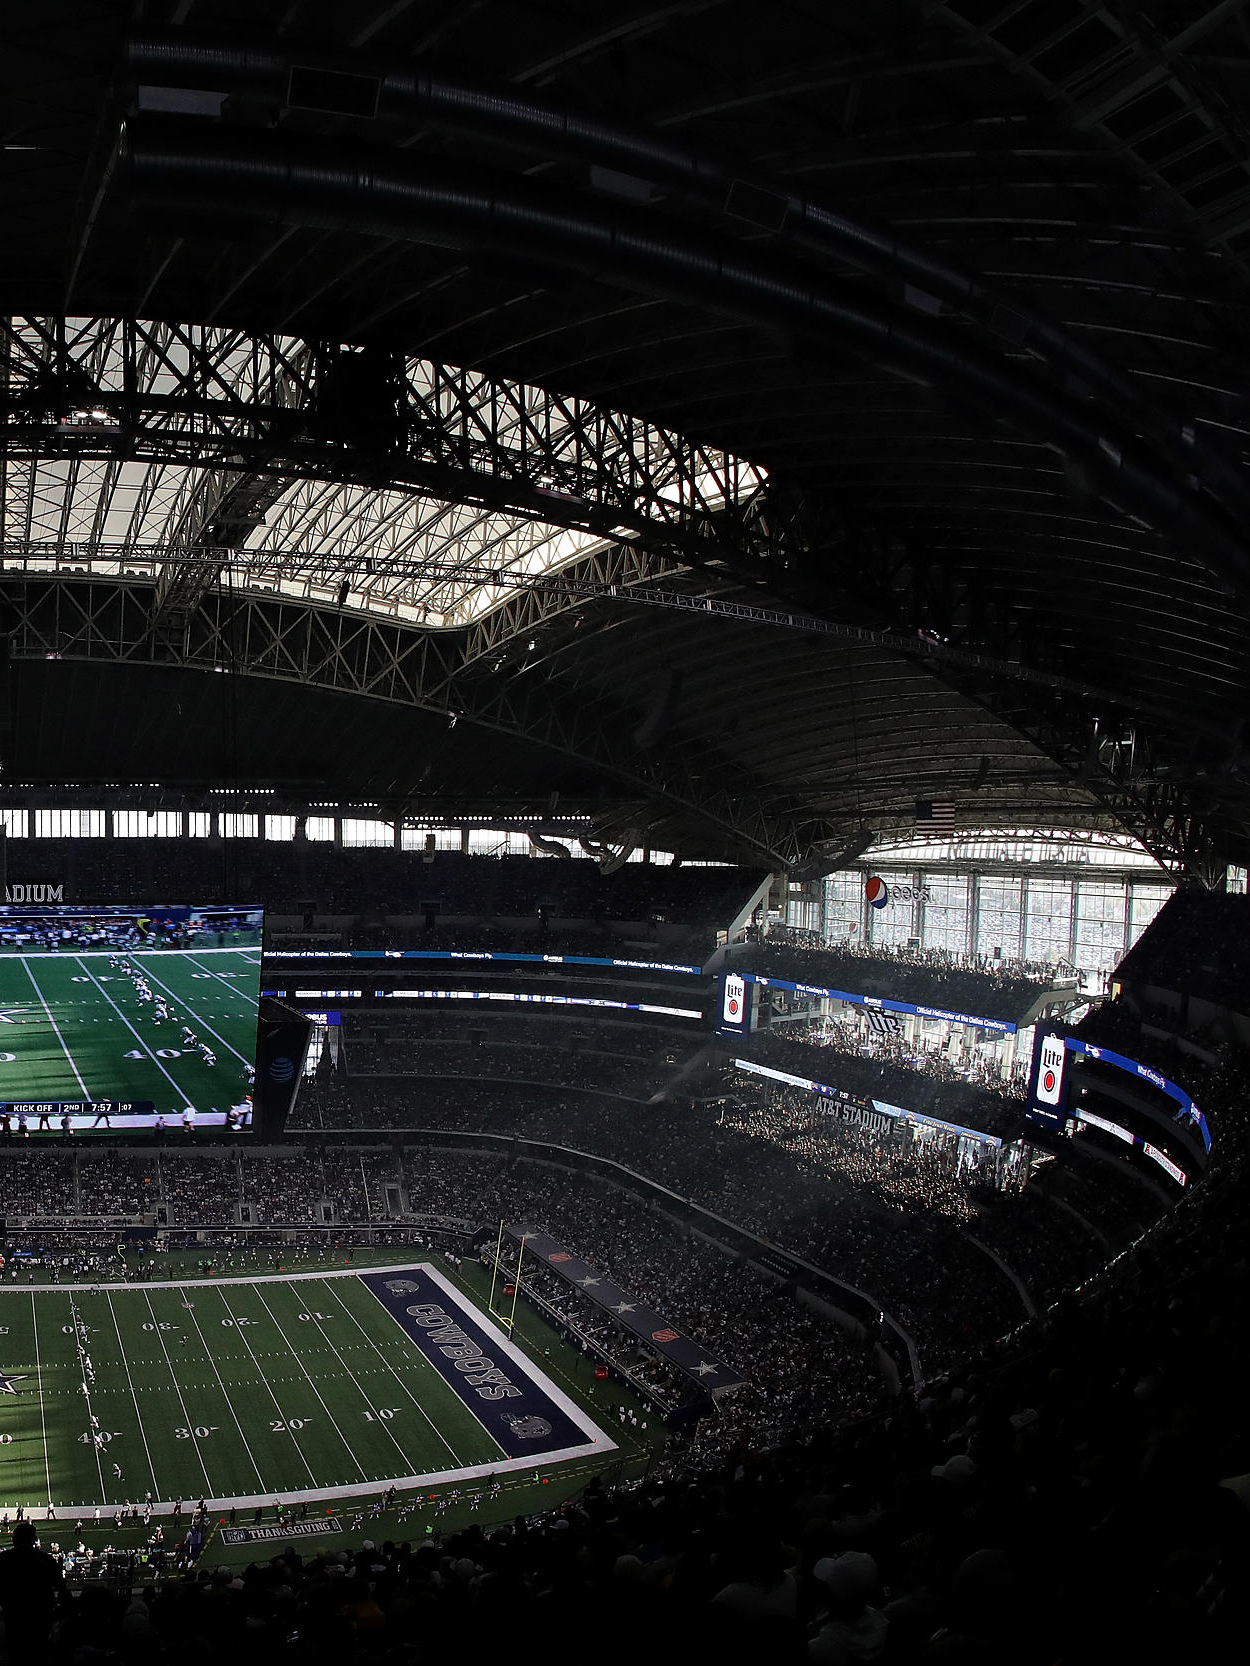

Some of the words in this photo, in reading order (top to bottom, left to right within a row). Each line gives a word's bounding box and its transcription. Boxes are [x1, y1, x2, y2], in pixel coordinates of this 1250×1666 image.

[727, 983, 743, 999] Lite
[1043, 1047, 1063, 1068] Lite
[13, 1104, 35, 1112] KICK
[36, 1104, 53, 1112] OFF
[63, 1104, 80, 1112] 2ND
[91, 1103, 112, 1112] 7:57
[121, 1103, 132, 1111] :07
[815, 1095, 842, 1118] AT&T
[843, 1104, 893, 1135] STADIUM
[406, 1303, 523, 1401] COWBOYS
[361, 1408, 396, 1423] 10
[174, 1426, 212, 1440] 30
[269, 1417, 305, 1433] 20
[249, 1521, 331, 1540] THANKSGIVING
